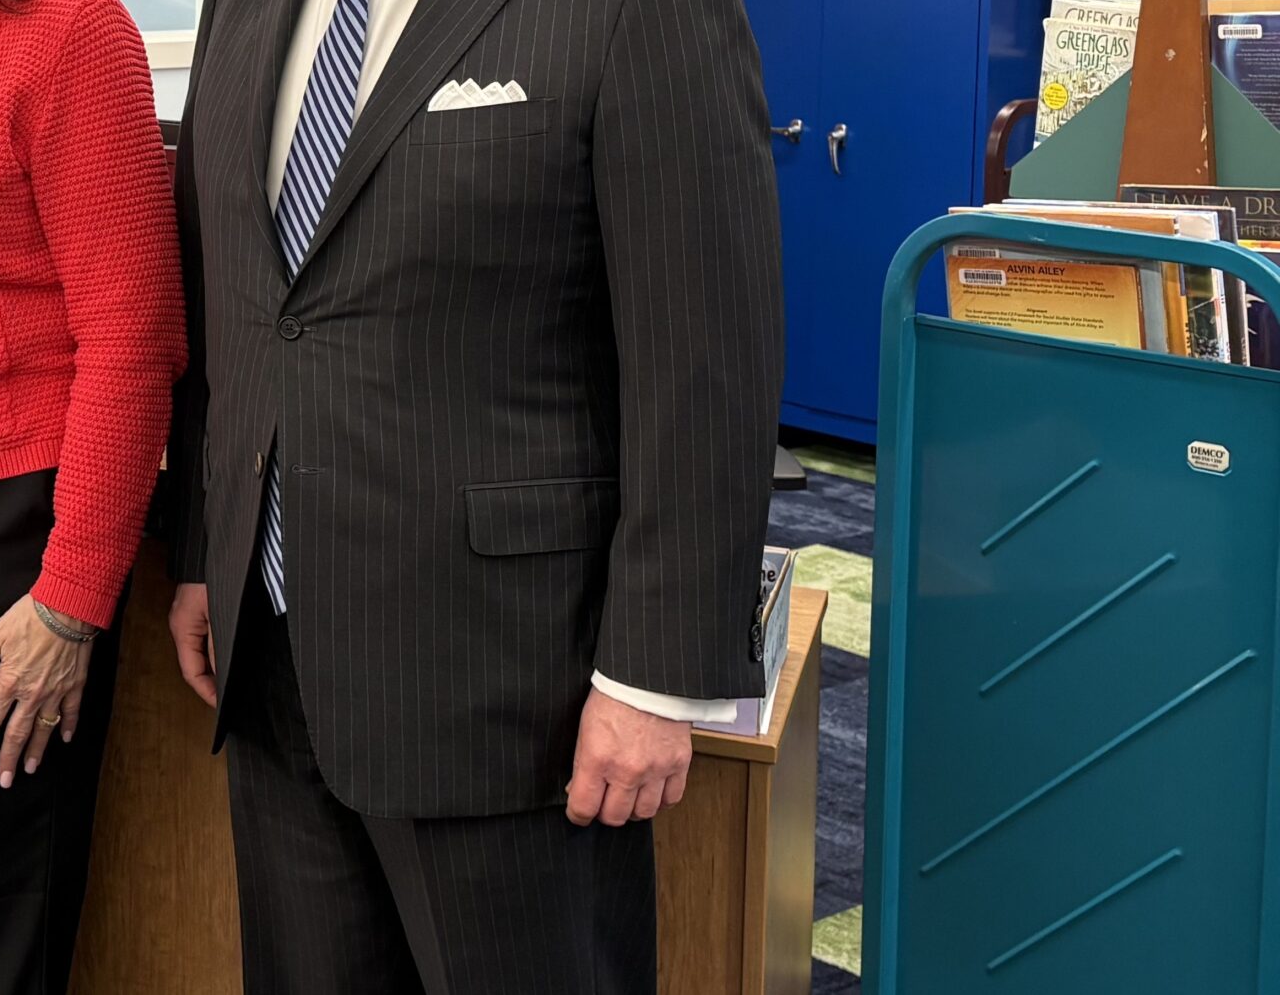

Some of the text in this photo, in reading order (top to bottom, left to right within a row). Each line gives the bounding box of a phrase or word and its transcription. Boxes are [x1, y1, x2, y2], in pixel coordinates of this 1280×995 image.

[1056, 30, 1129, 58] GREENGLASS
[1076, 52, 1112, 75] HOUSE
[1007, 264, 1066, 276] ALVIN AILEY
[1190, 446, 1224, 458] DEMCO
